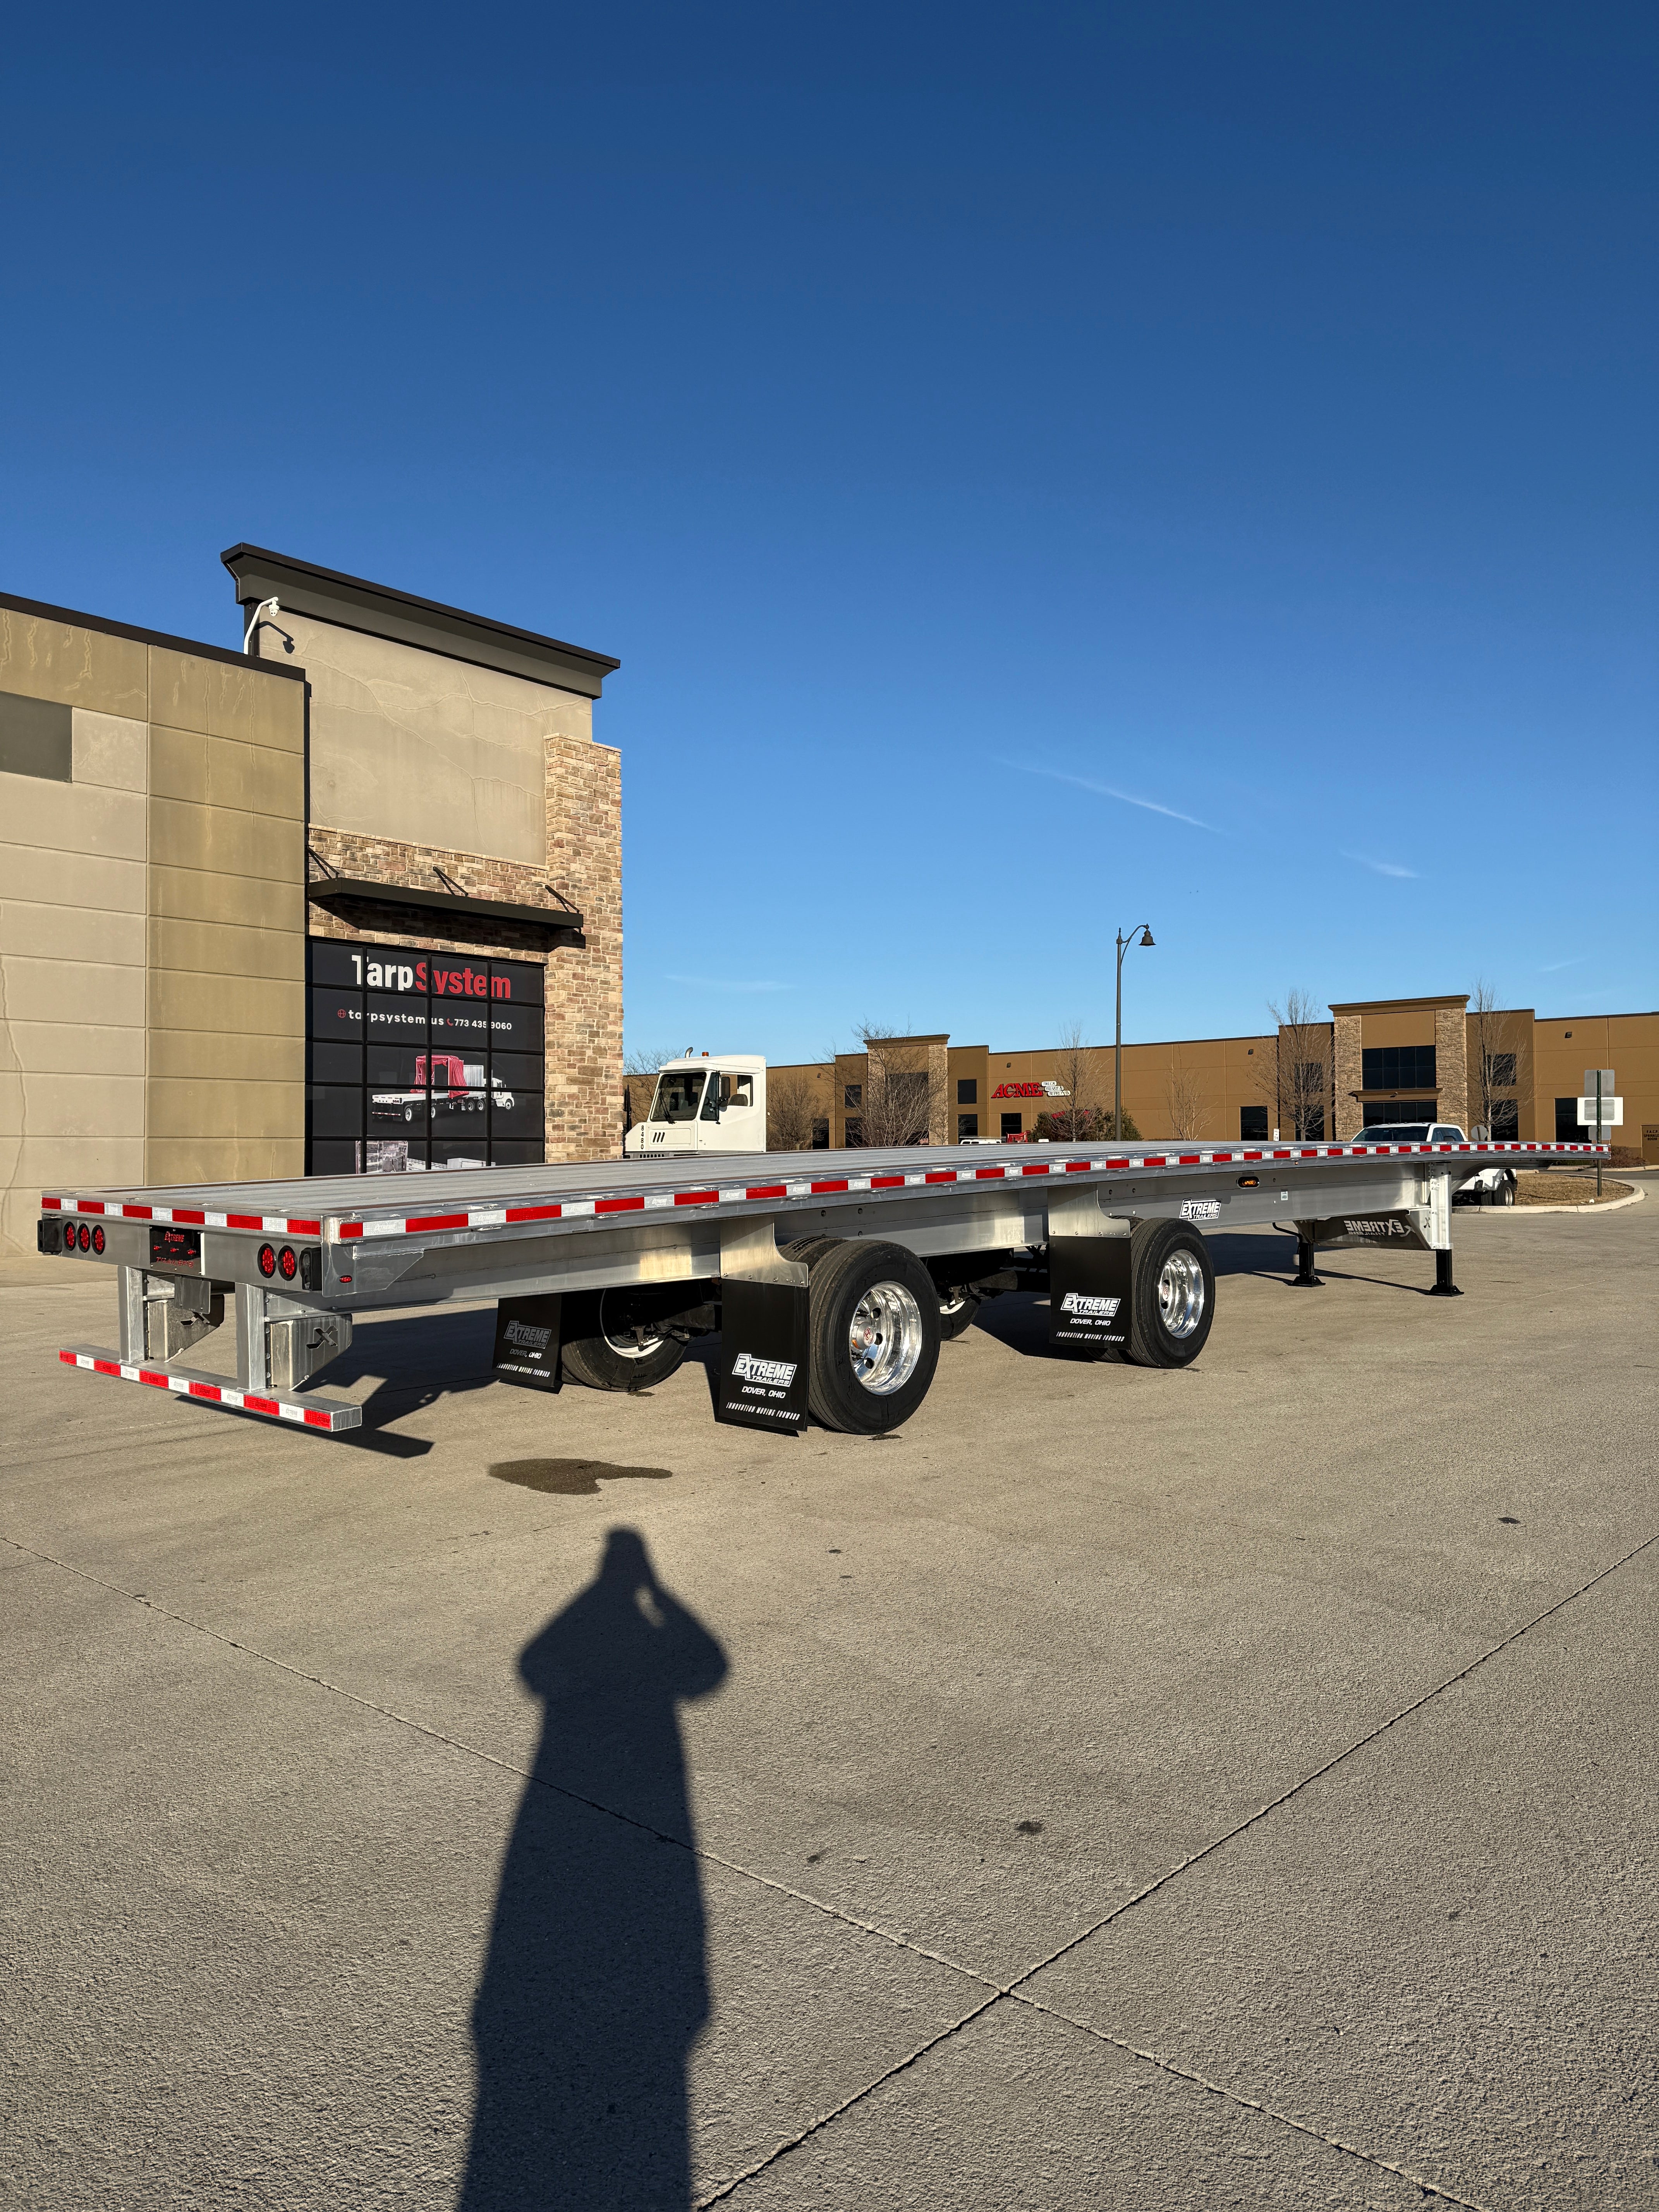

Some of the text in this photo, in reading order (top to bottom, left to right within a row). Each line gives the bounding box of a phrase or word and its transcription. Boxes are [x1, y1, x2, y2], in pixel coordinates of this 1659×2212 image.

[454, 1018, 512, 1030] 773 435 9060
[991, 1082, 1043, 1098] ACME
[1181, 1200, 1220, 1219] EXTREME
[1063, 1294, 1118, 1312] EXTREME
[506, 1322, 550, 1343] EXTREME
[518, 1340, 546, 1348] TRAILERS
[510, 1348, 527, 1357] DOVER,
[735, 1355, 795, 1380] EXTREME
[752, 1375, 790, 1385] TRAILERS
[741, 1386, 786, 1399] DOVER, OHIO
